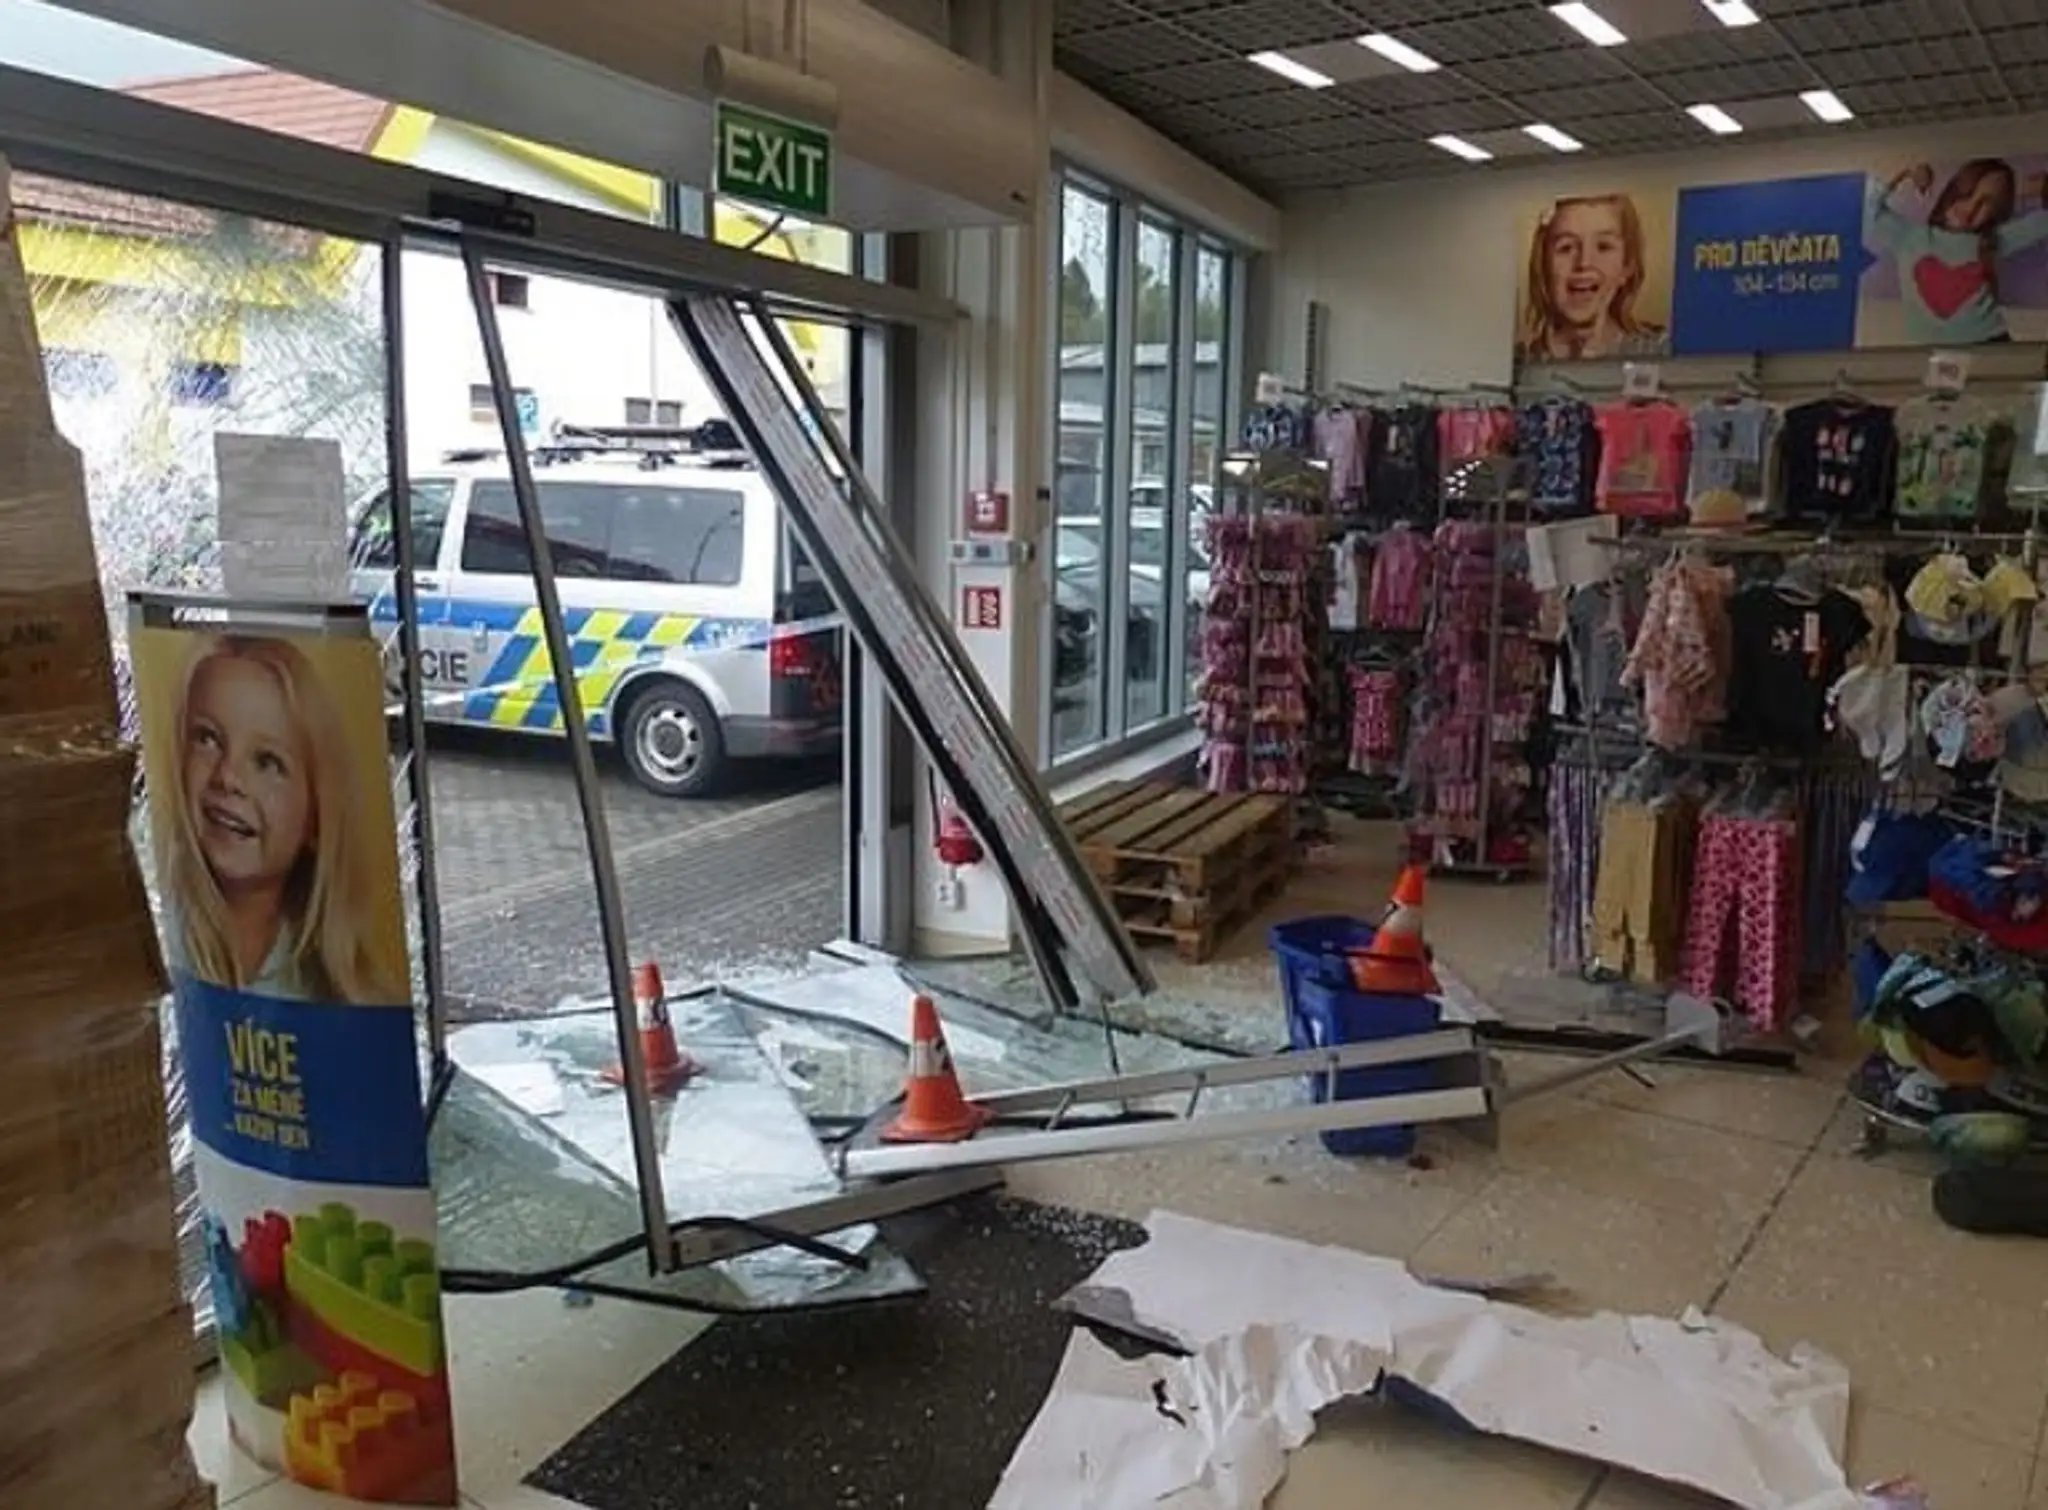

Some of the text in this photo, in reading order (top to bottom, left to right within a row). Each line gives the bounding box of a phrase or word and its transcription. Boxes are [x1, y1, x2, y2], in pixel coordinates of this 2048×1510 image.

[725, 122, 824, 198] EXIT
[1694, 240, 1736, 271] PRO
[224, 1015, 301, 1082] VÍCE
